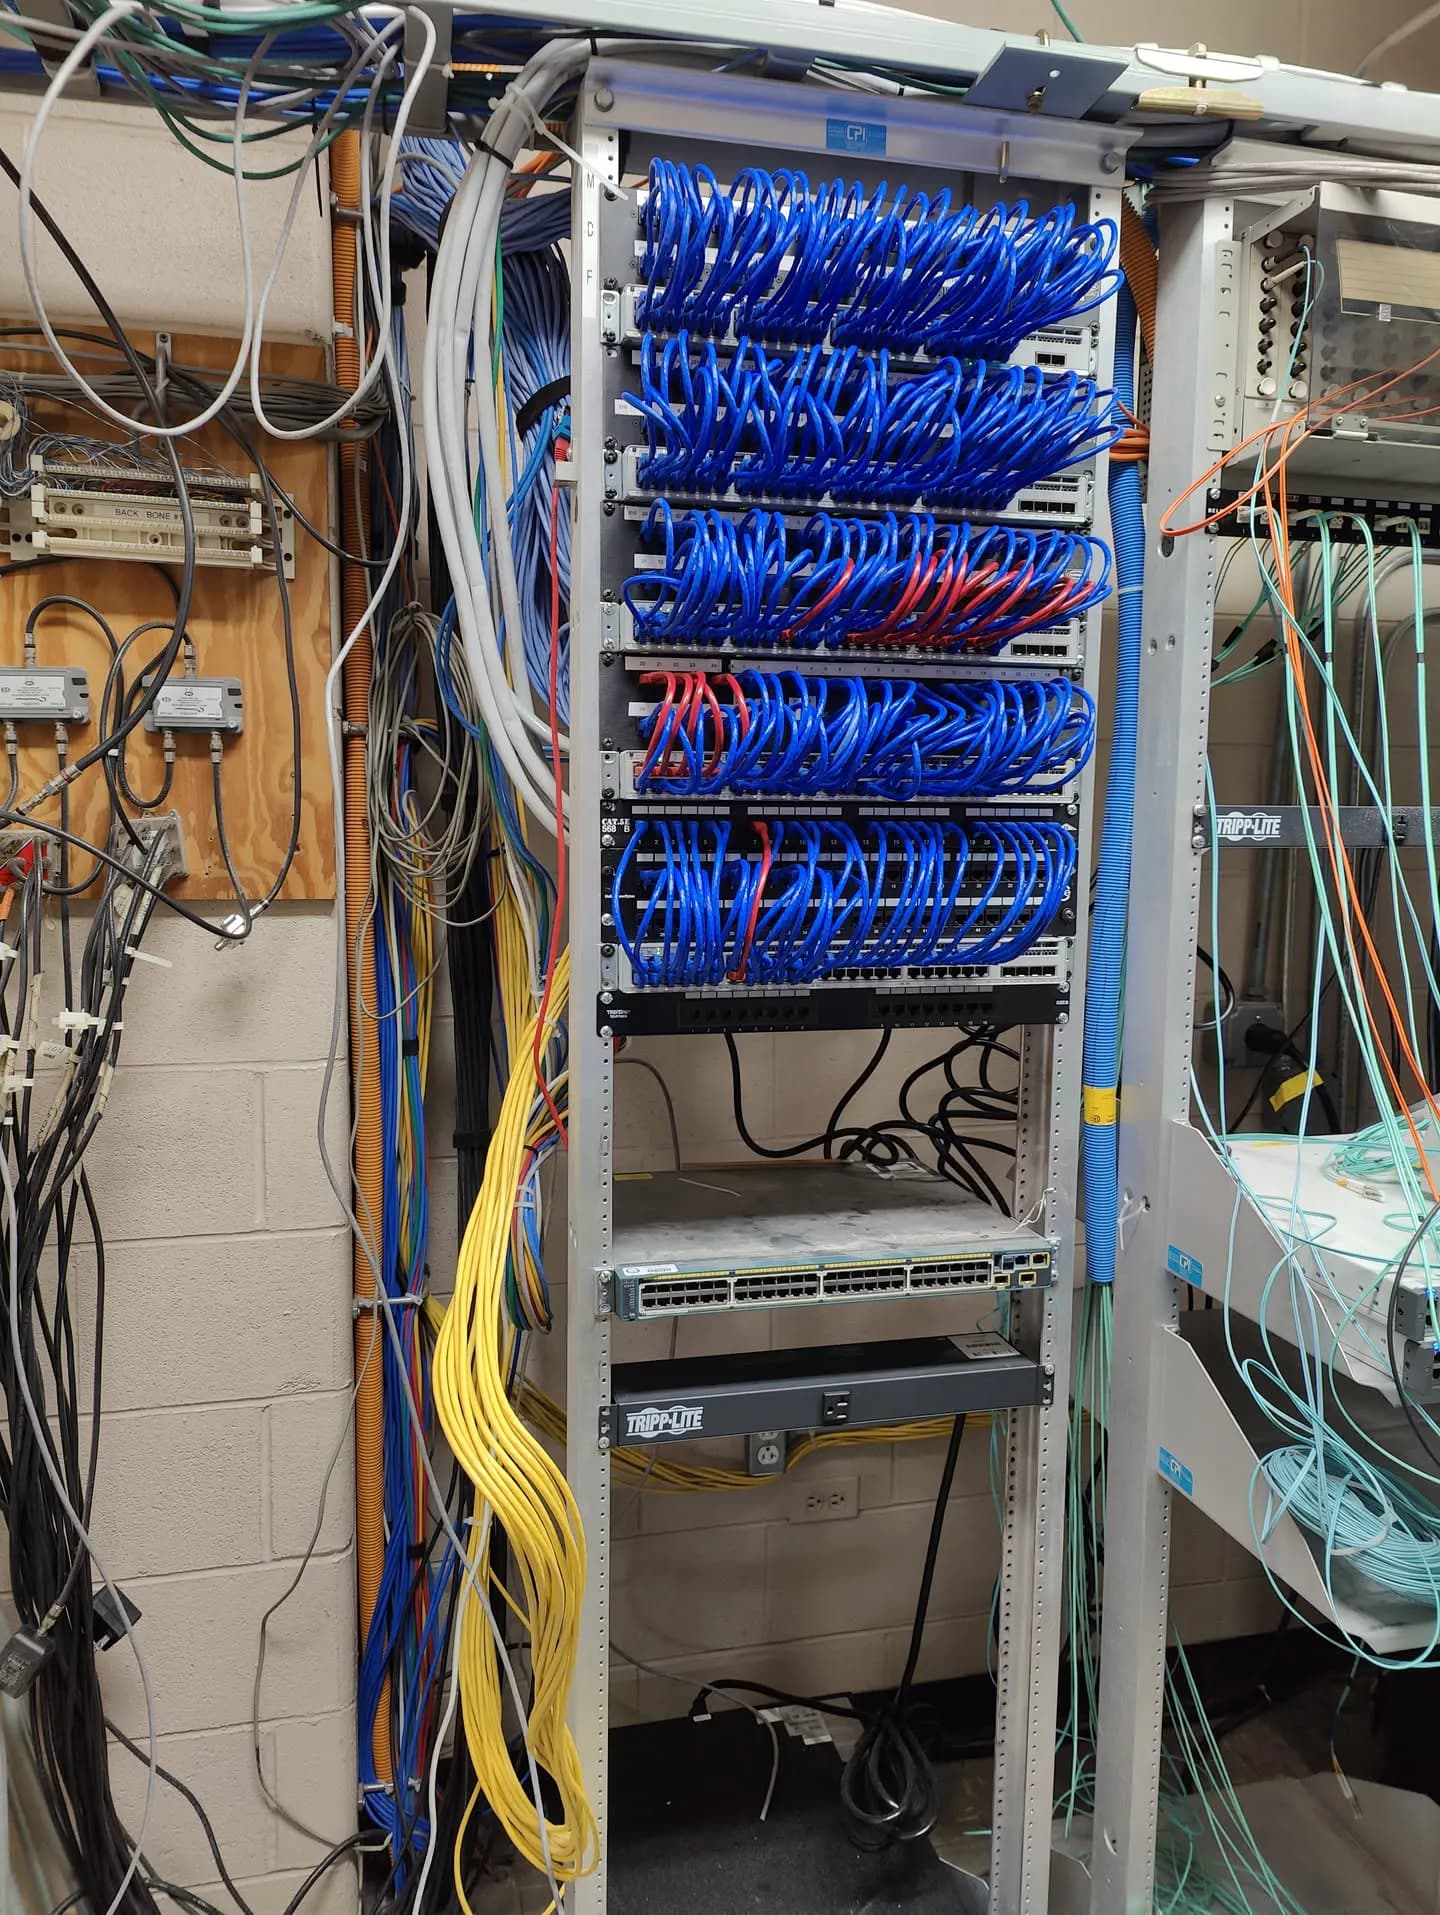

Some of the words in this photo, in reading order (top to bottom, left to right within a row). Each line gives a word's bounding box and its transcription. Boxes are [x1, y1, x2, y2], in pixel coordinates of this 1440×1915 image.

[586, 173, 595, 188] M
[587, 221, 594, 237] D
[586, 269, 593, 285] F
[115, 508, 139, 517] BACK
[146, 511, 171, 520] BONE
[601, 818, 631, 826] CAT.5E
[601, 825, 616, 833] 568
[624, 825, 631, 833] B
